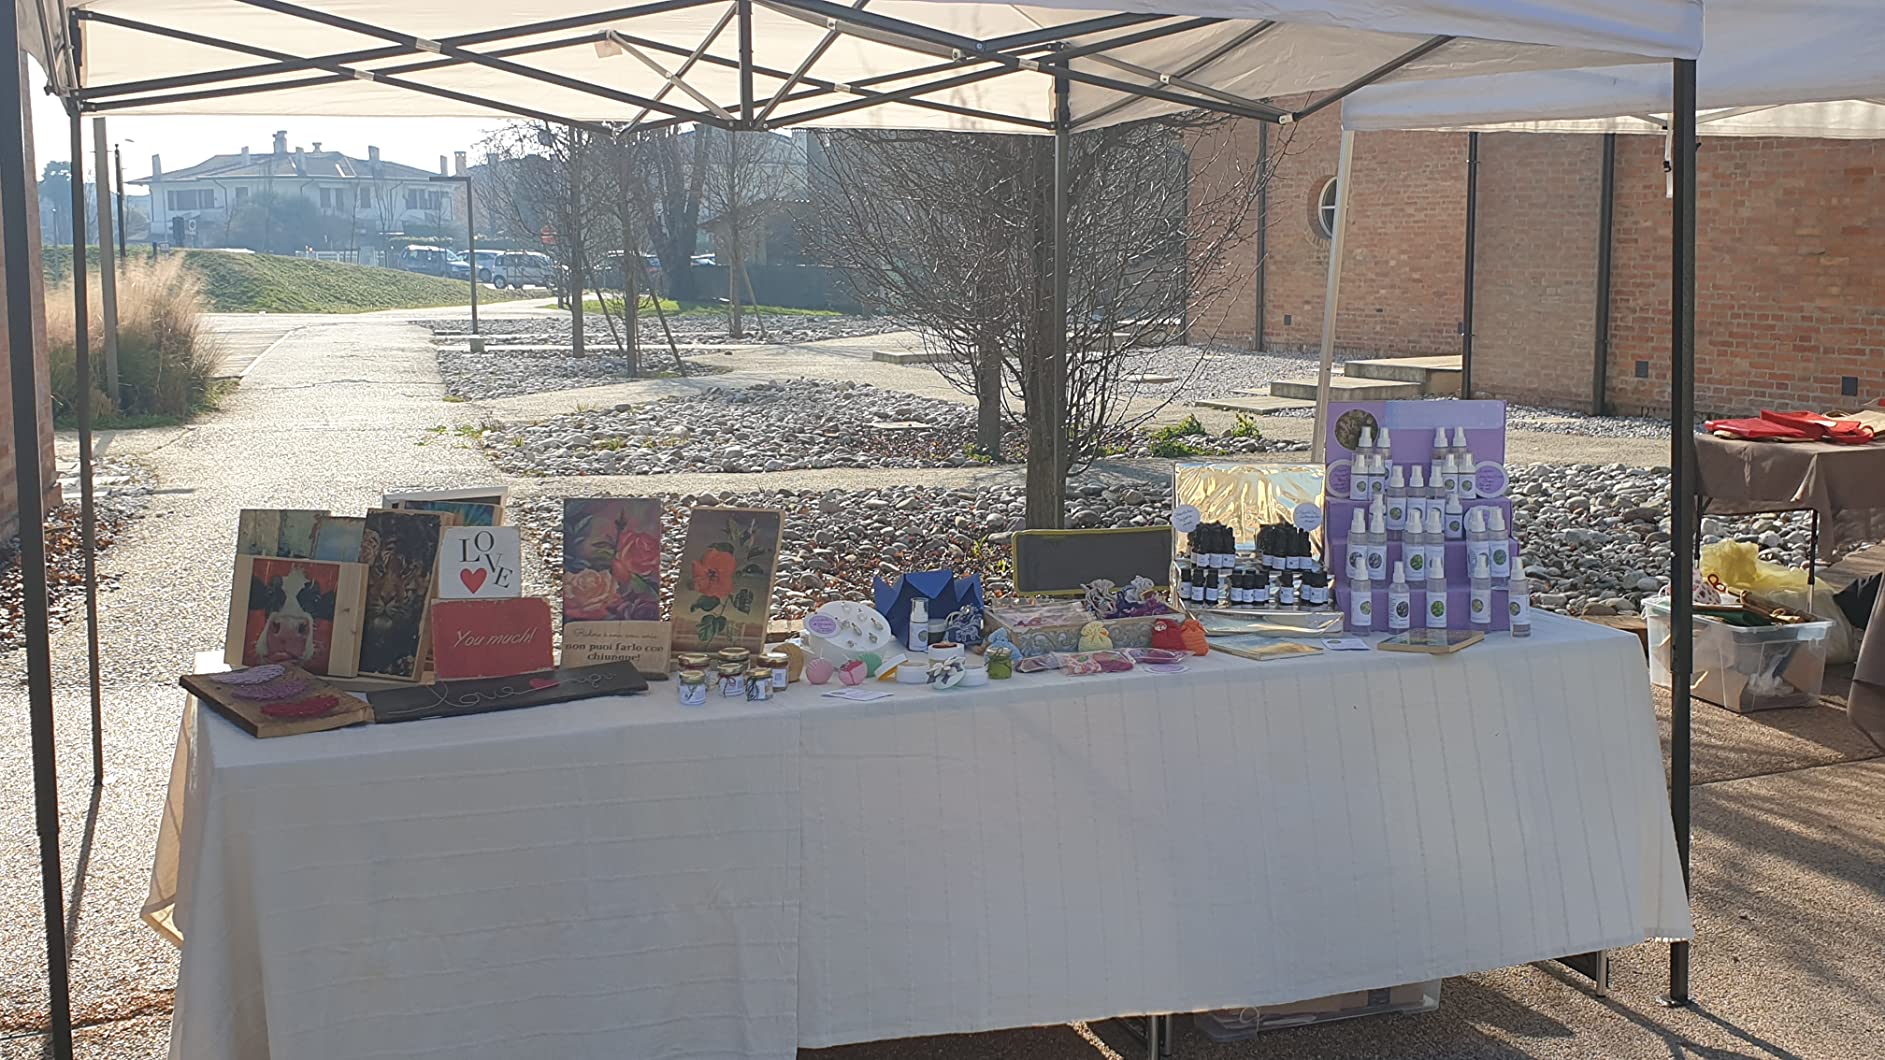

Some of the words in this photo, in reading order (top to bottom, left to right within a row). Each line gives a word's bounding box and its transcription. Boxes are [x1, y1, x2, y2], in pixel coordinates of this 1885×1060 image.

[459, 530, 513, 589] LOVE
[453, 630, 484, 648] You
[487, 626, 537, 646] much!
[565, 642, 586, 650] non
[589, 643, 612, 652] puoi
[615, 642, 642, 652] farlo
